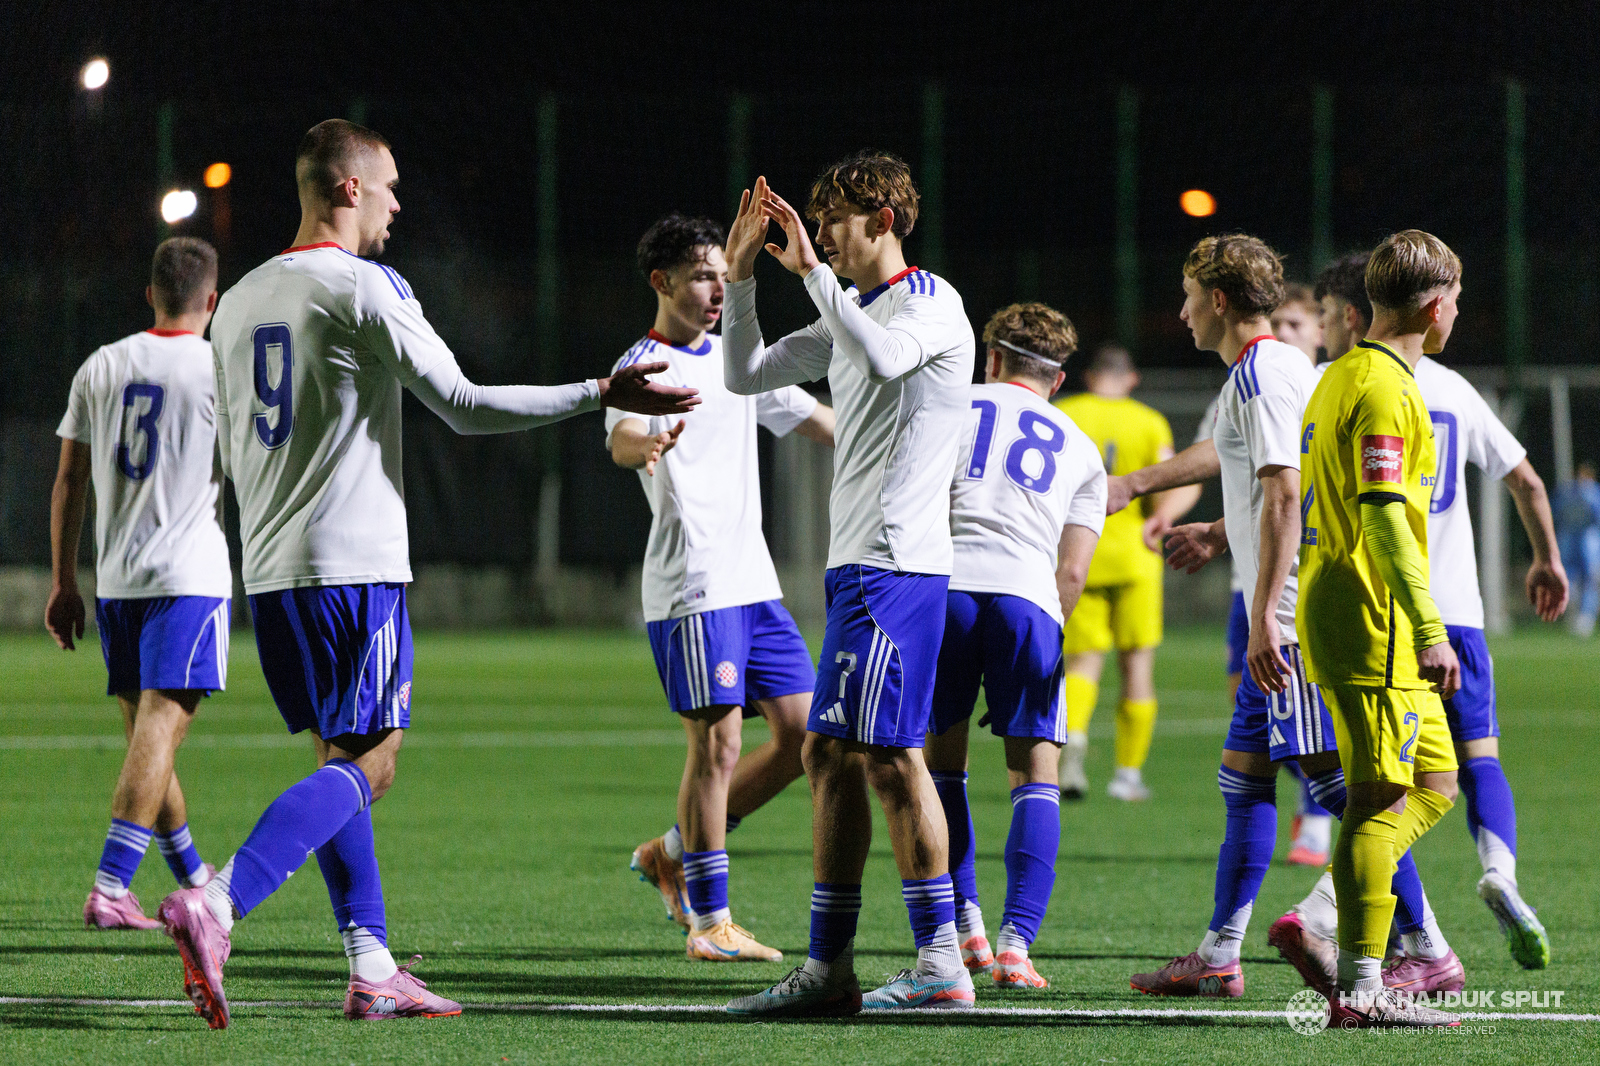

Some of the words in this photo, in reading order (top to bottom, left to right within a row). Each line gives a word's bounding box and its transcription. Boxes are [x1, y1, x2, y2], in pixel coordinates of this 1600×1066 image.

[251, 322, 296, 451] 9
[115, 380, 167, 481] 3
[964, 399, 1069, 496] 18
[1363, 446, 1401, 458] Super
[1365, 457, 1399, 470] Sport
[834, 650, 857, 699] 7
[1398, 711, 1419, 765] 2
